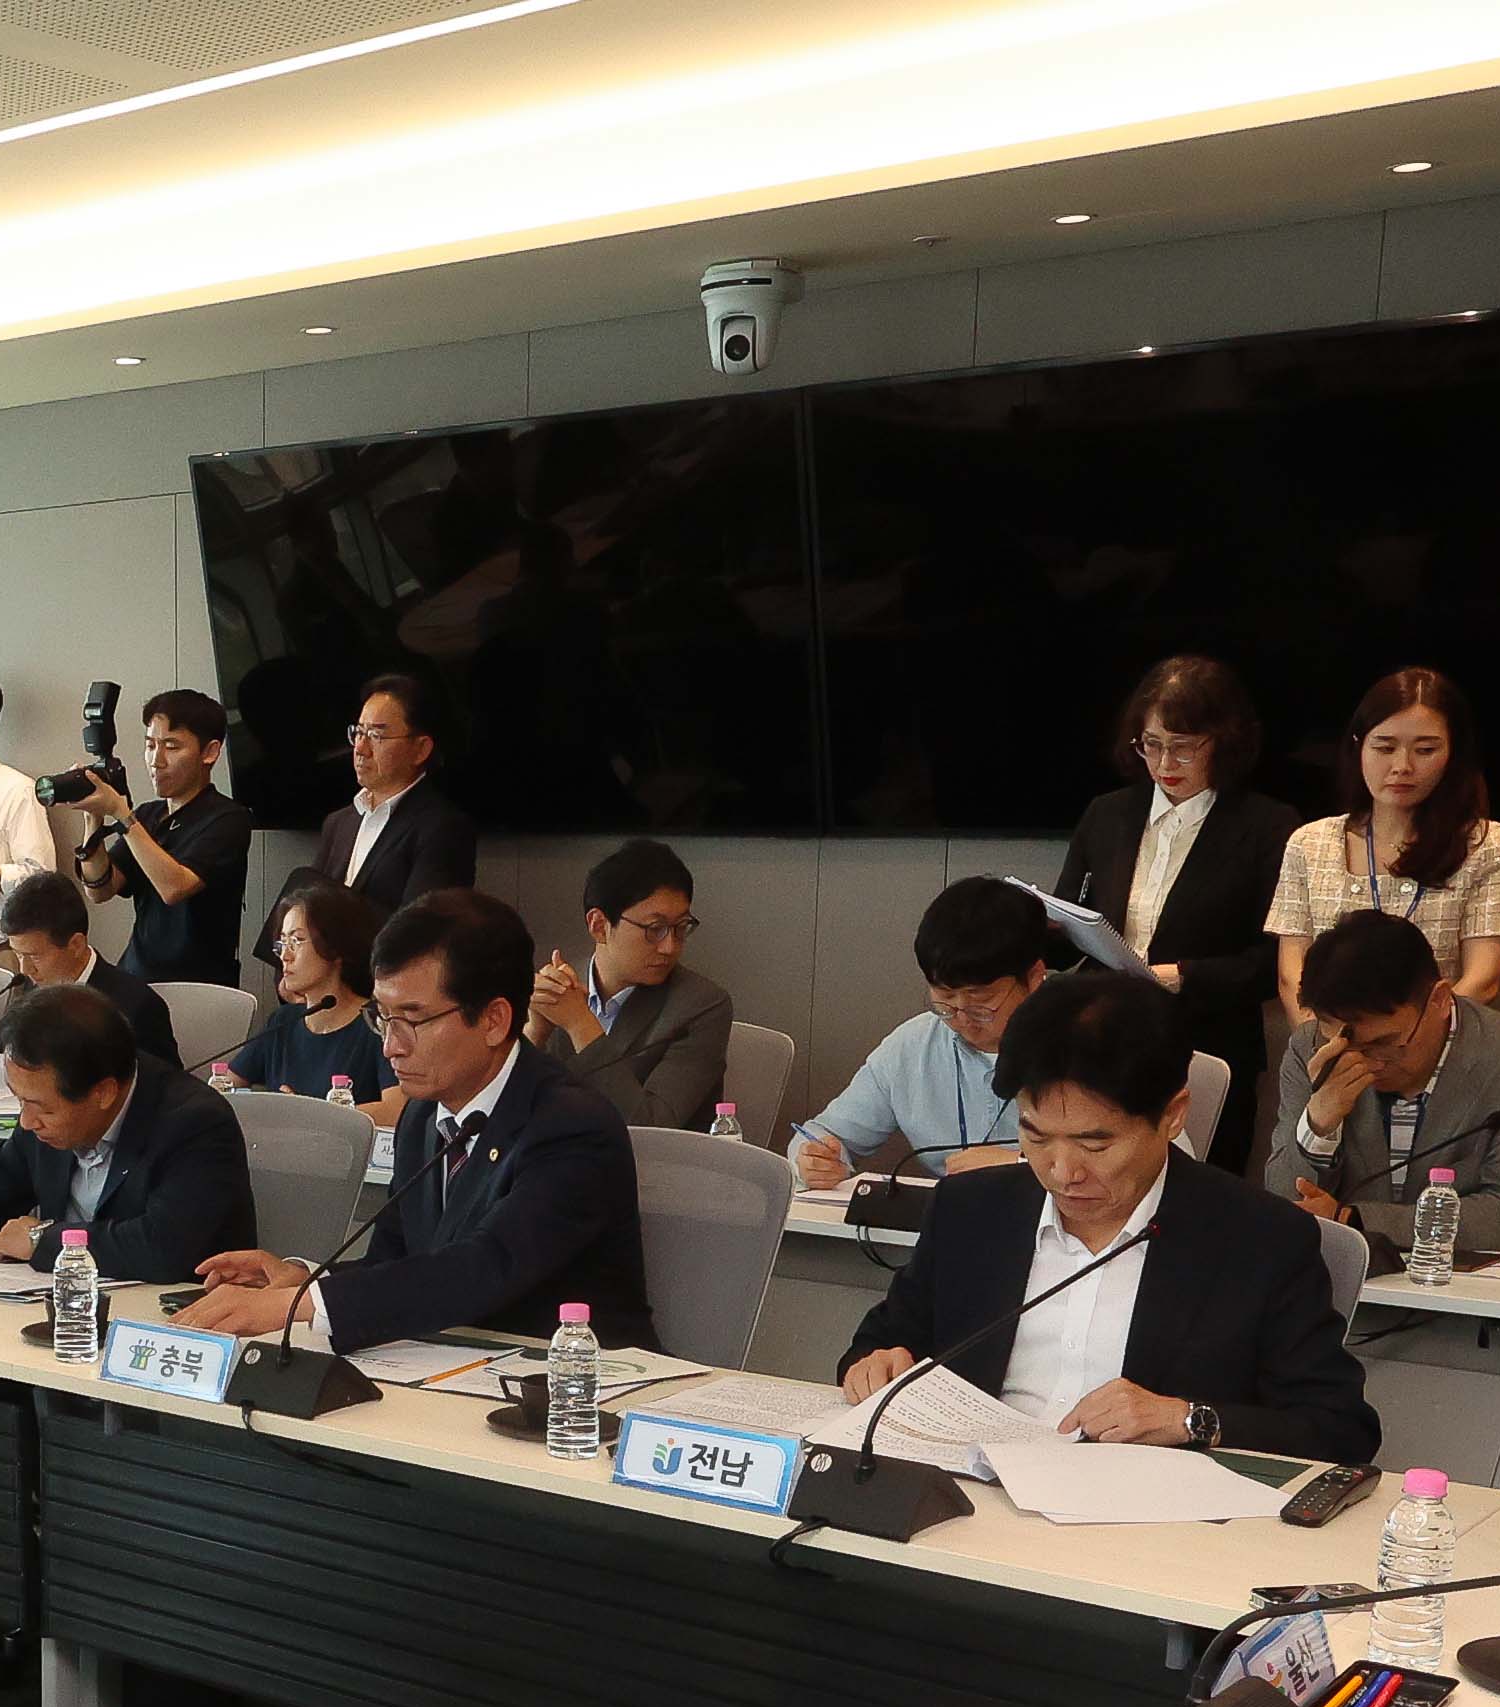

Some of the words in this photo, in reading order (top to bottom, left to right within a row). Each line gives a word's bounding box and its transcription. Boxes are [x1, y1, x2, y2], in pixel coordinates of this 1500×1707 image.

[157, 1343, 204, 1385] 충북
[686, 1441, 756, 1488] 전남
[1284, 1633, 1320, 1697] 울산
